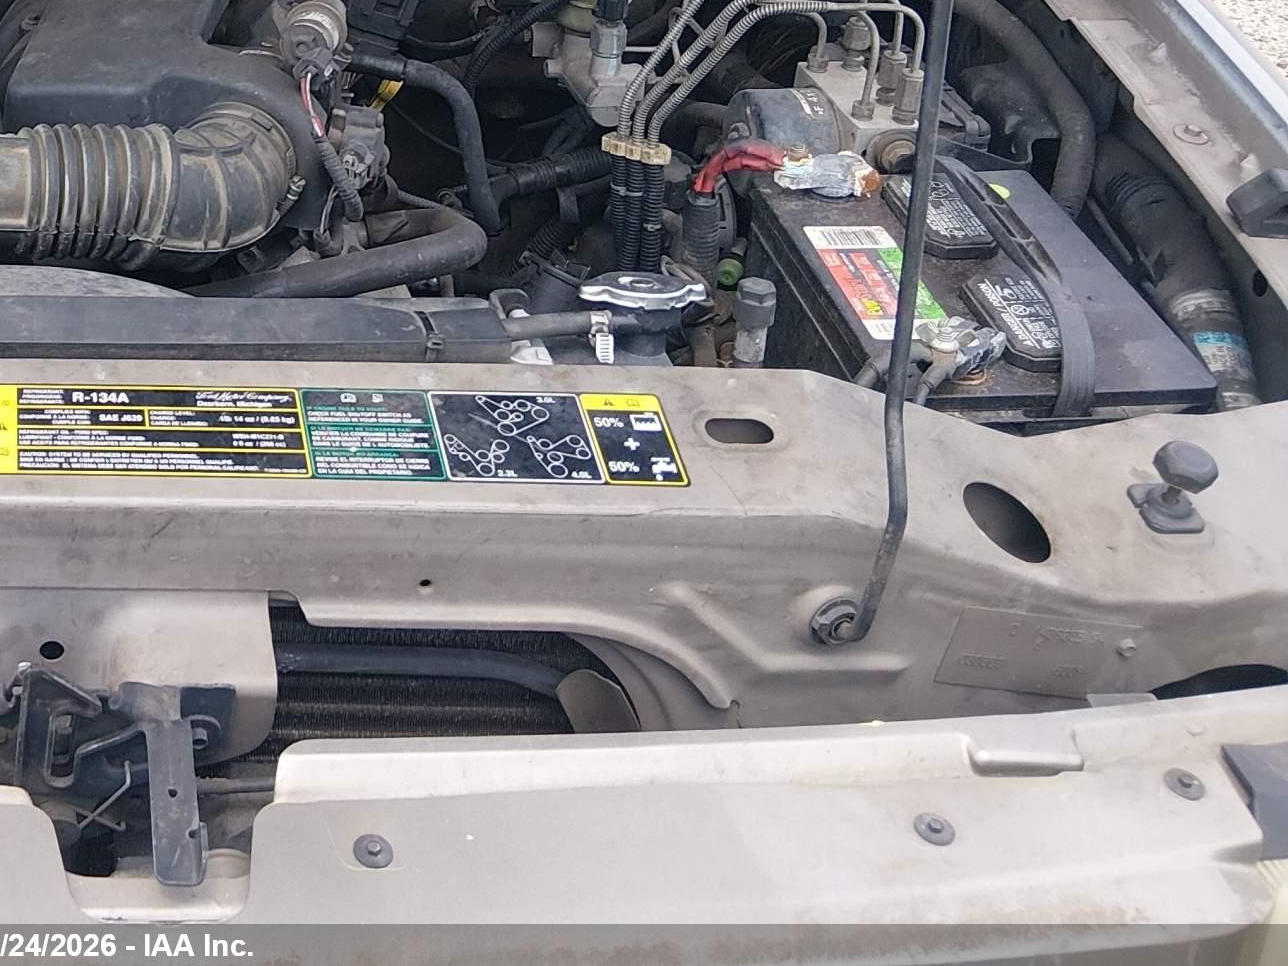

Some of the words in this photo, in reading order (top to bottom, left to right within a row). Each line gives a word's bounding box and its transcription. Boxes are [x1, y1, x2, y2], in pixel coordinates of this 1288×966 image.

[72, 392, 130, 403] R-134A
[99, 414, 120, 422] SAE
[593, 416, 625, 429] 50%
[608, 460, 640, 473] 50%
